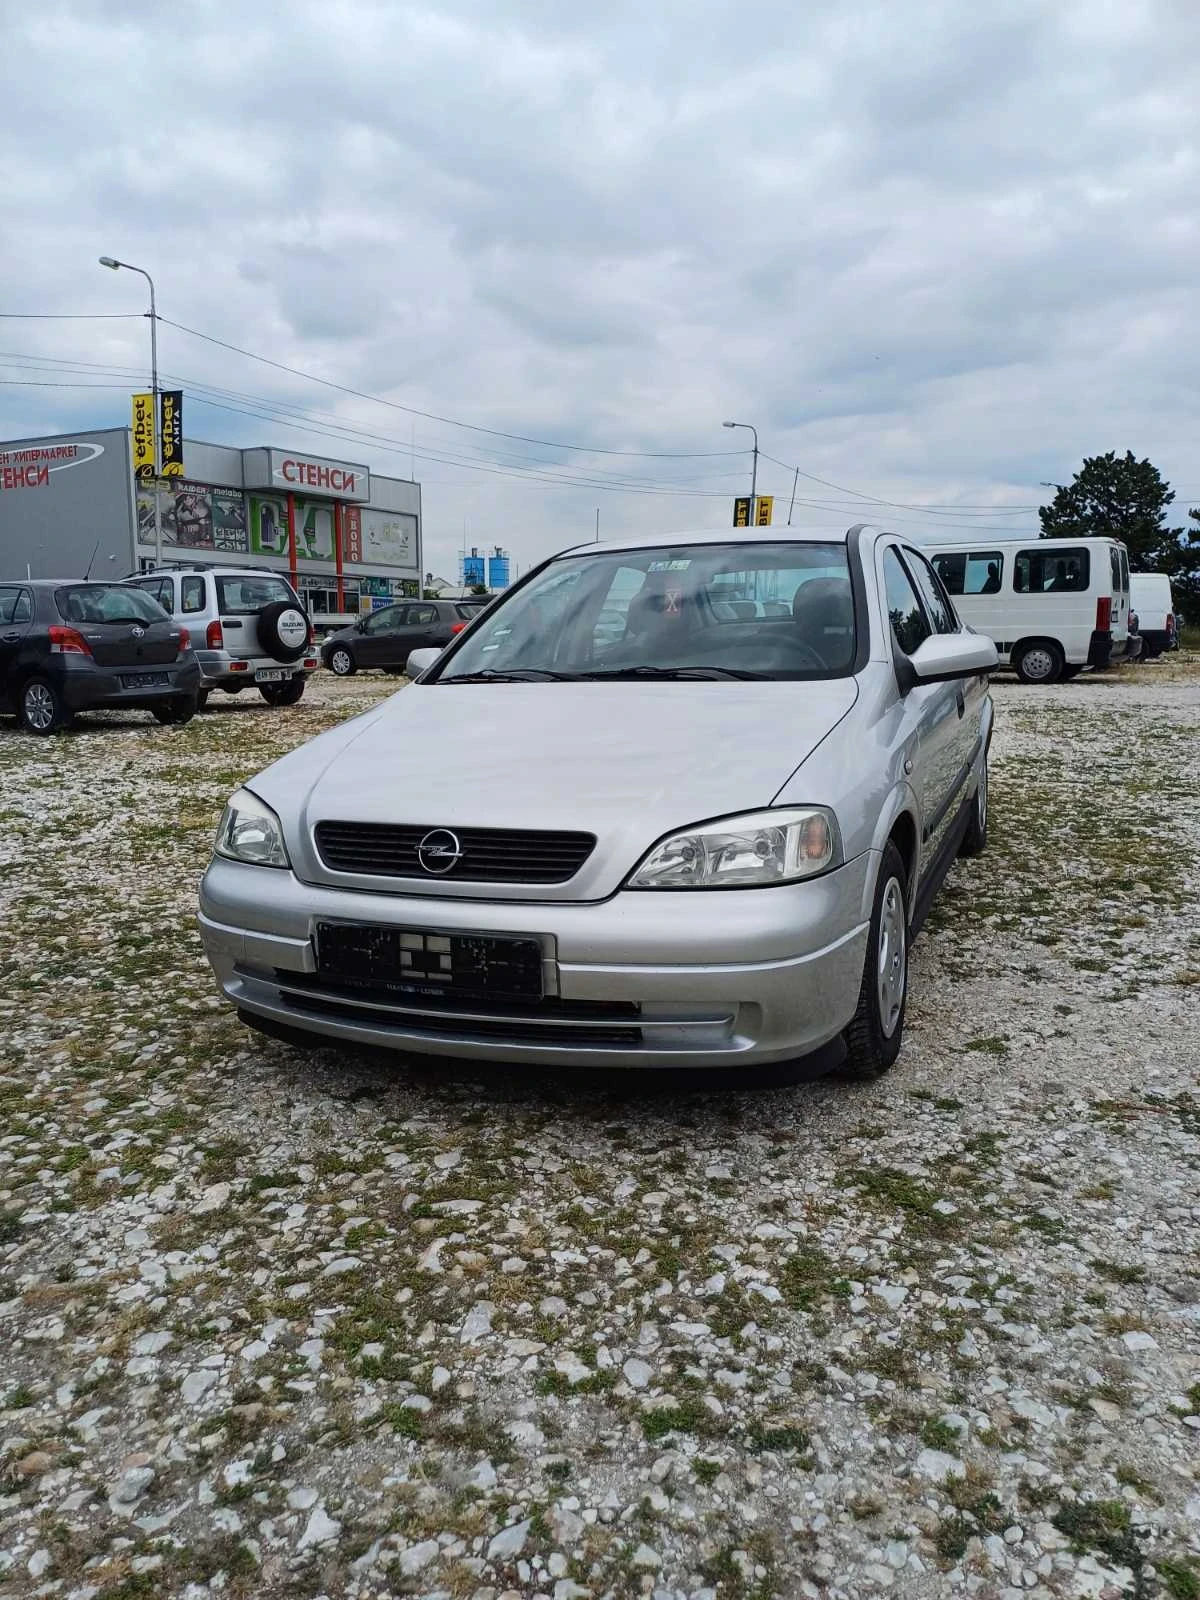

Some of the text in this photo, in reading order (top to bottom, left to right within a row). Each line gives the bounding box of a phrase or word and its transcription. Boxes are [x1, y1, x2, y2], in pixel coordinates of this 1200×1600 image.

[135, 399, 146, 457] efbet
[163, 396, 173, 457] efbet
[14, 445, 79, 463] ХИПЕРМАРКЕТ
[282, 460, 355, 492] СТЕНСИ
